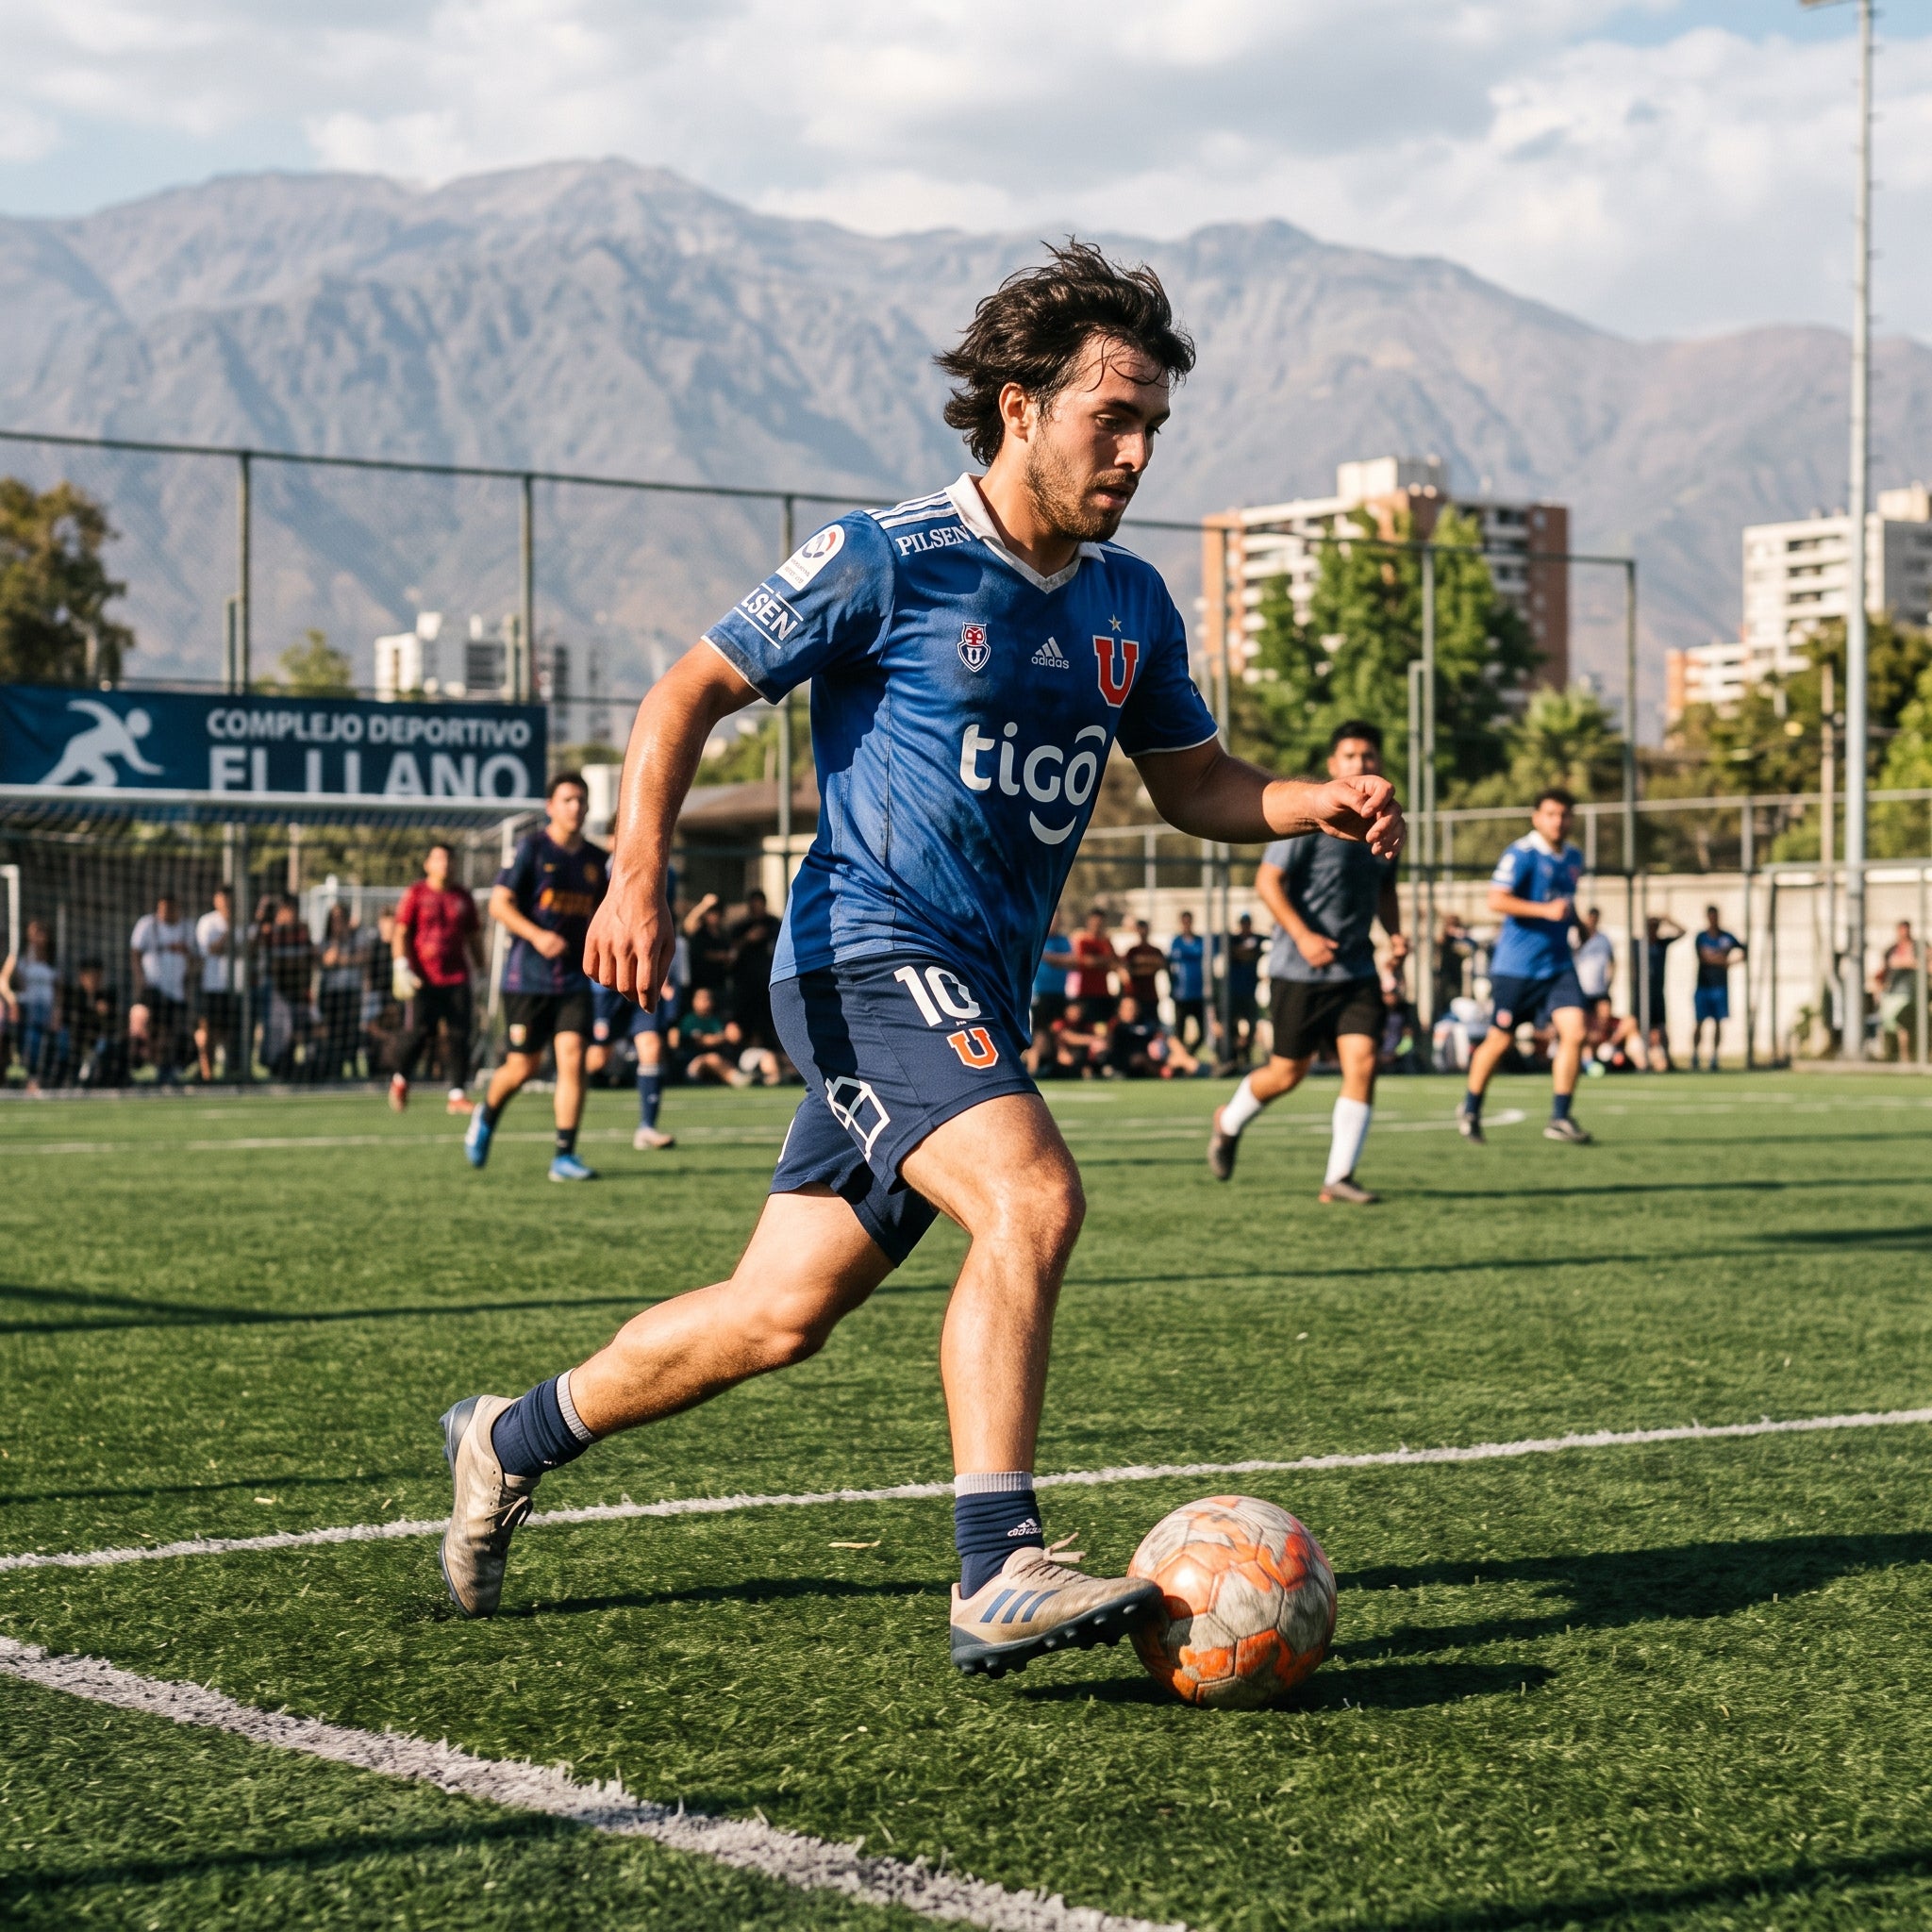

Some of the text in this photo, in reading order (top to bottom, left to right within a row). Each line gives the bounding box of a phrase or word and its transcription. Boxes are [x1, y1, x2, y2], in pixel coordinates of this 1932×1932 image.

[895, 525, 971, 557] PILSEN
[1031, 655, 1070, 670] adidas
[1092, 635, 1140, 708] U
[207, 708, 531, 748] COMPLEJO DEPORTIVO
[893, 965, 982, 1027] 10
[946, 1026, 1000, 1070] U
